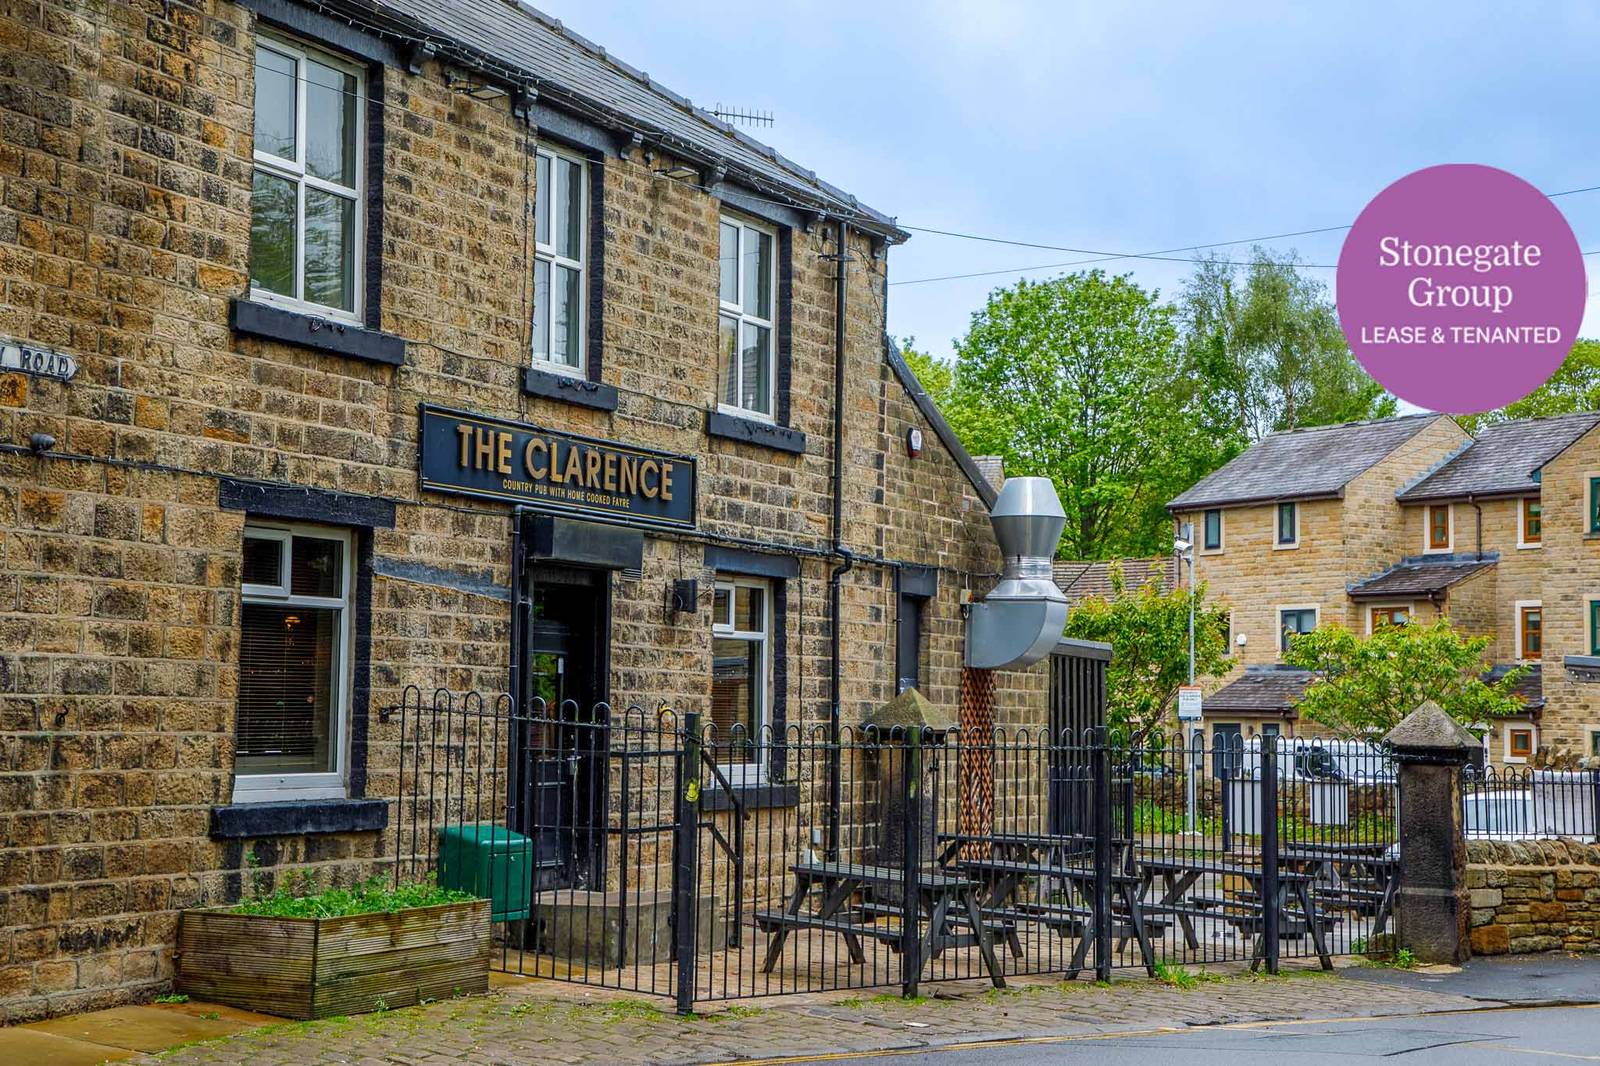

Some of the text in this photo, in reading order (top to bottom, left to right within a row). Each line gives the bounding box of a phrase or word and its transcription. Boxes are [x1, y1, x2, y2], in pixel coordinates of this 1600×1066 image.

[20, 349, 69, 376] ROAD
[457, 424, 673, 501] THE CLARENCE
[502, 479, 630, 508] COUNTRY PUB WITH HOME COOKED FAYRE
